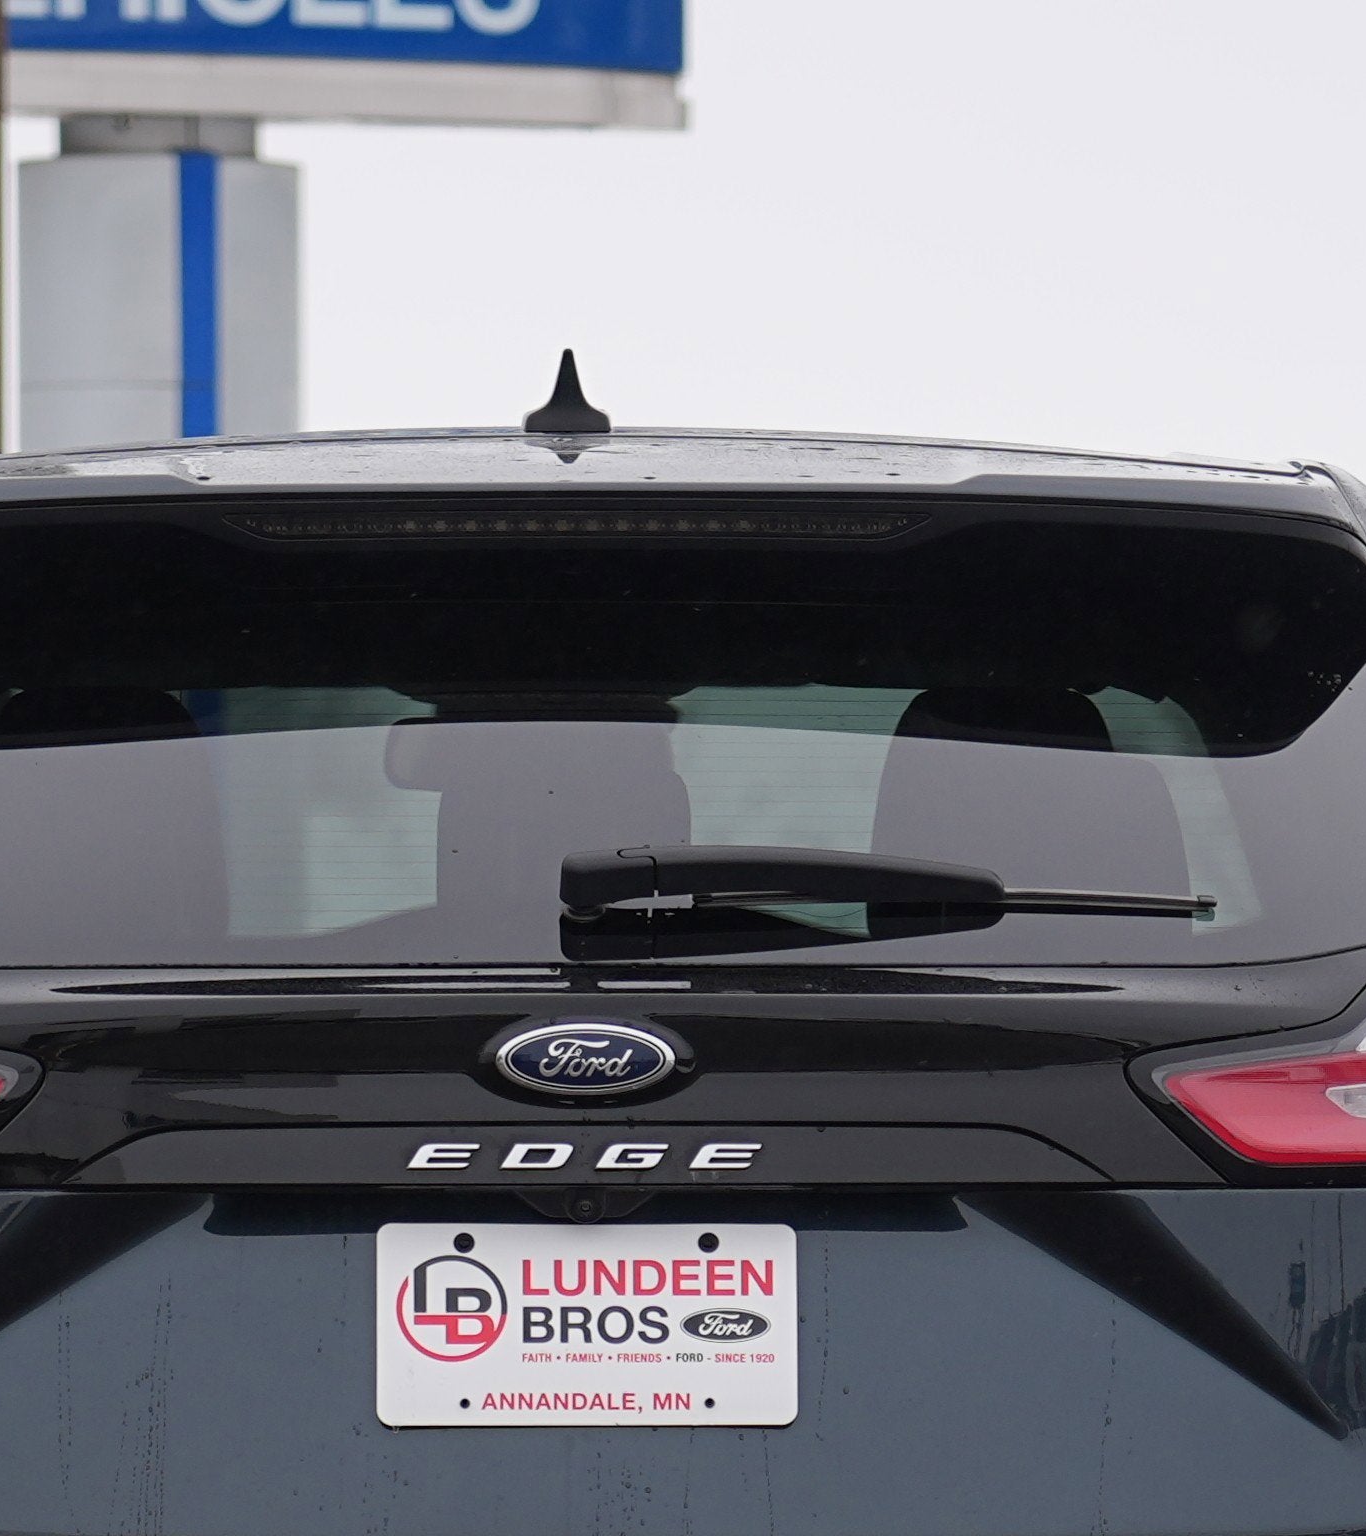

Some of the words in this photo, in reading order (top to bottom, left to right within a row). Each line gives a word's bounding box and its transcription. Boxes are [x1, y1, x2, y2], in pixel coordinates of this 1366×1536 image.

[538, 1037, 634, 1079] Ford
[406, 1142, 763, 1170] EDGE
[522, 1259, 774, 1297] LUNDEEN
[522, 1306, 670, 1344] BROS
[698, 1312, 754, 1336] Ford
[521, 1352, 552, 1364] FAITH
[565, 1352, 604, 1364] FAMILY
[616, 1352, 662, 1364] FRIENDS
[675, 1352, 704, 1364] FORD
[714, 1352, 746, 1364] SINCE
[749, 1352, 775, 1364] 1920
[481, 1392, 643, 1414] ANNANDALE,
[652, 1392, 691, 1411] MN
